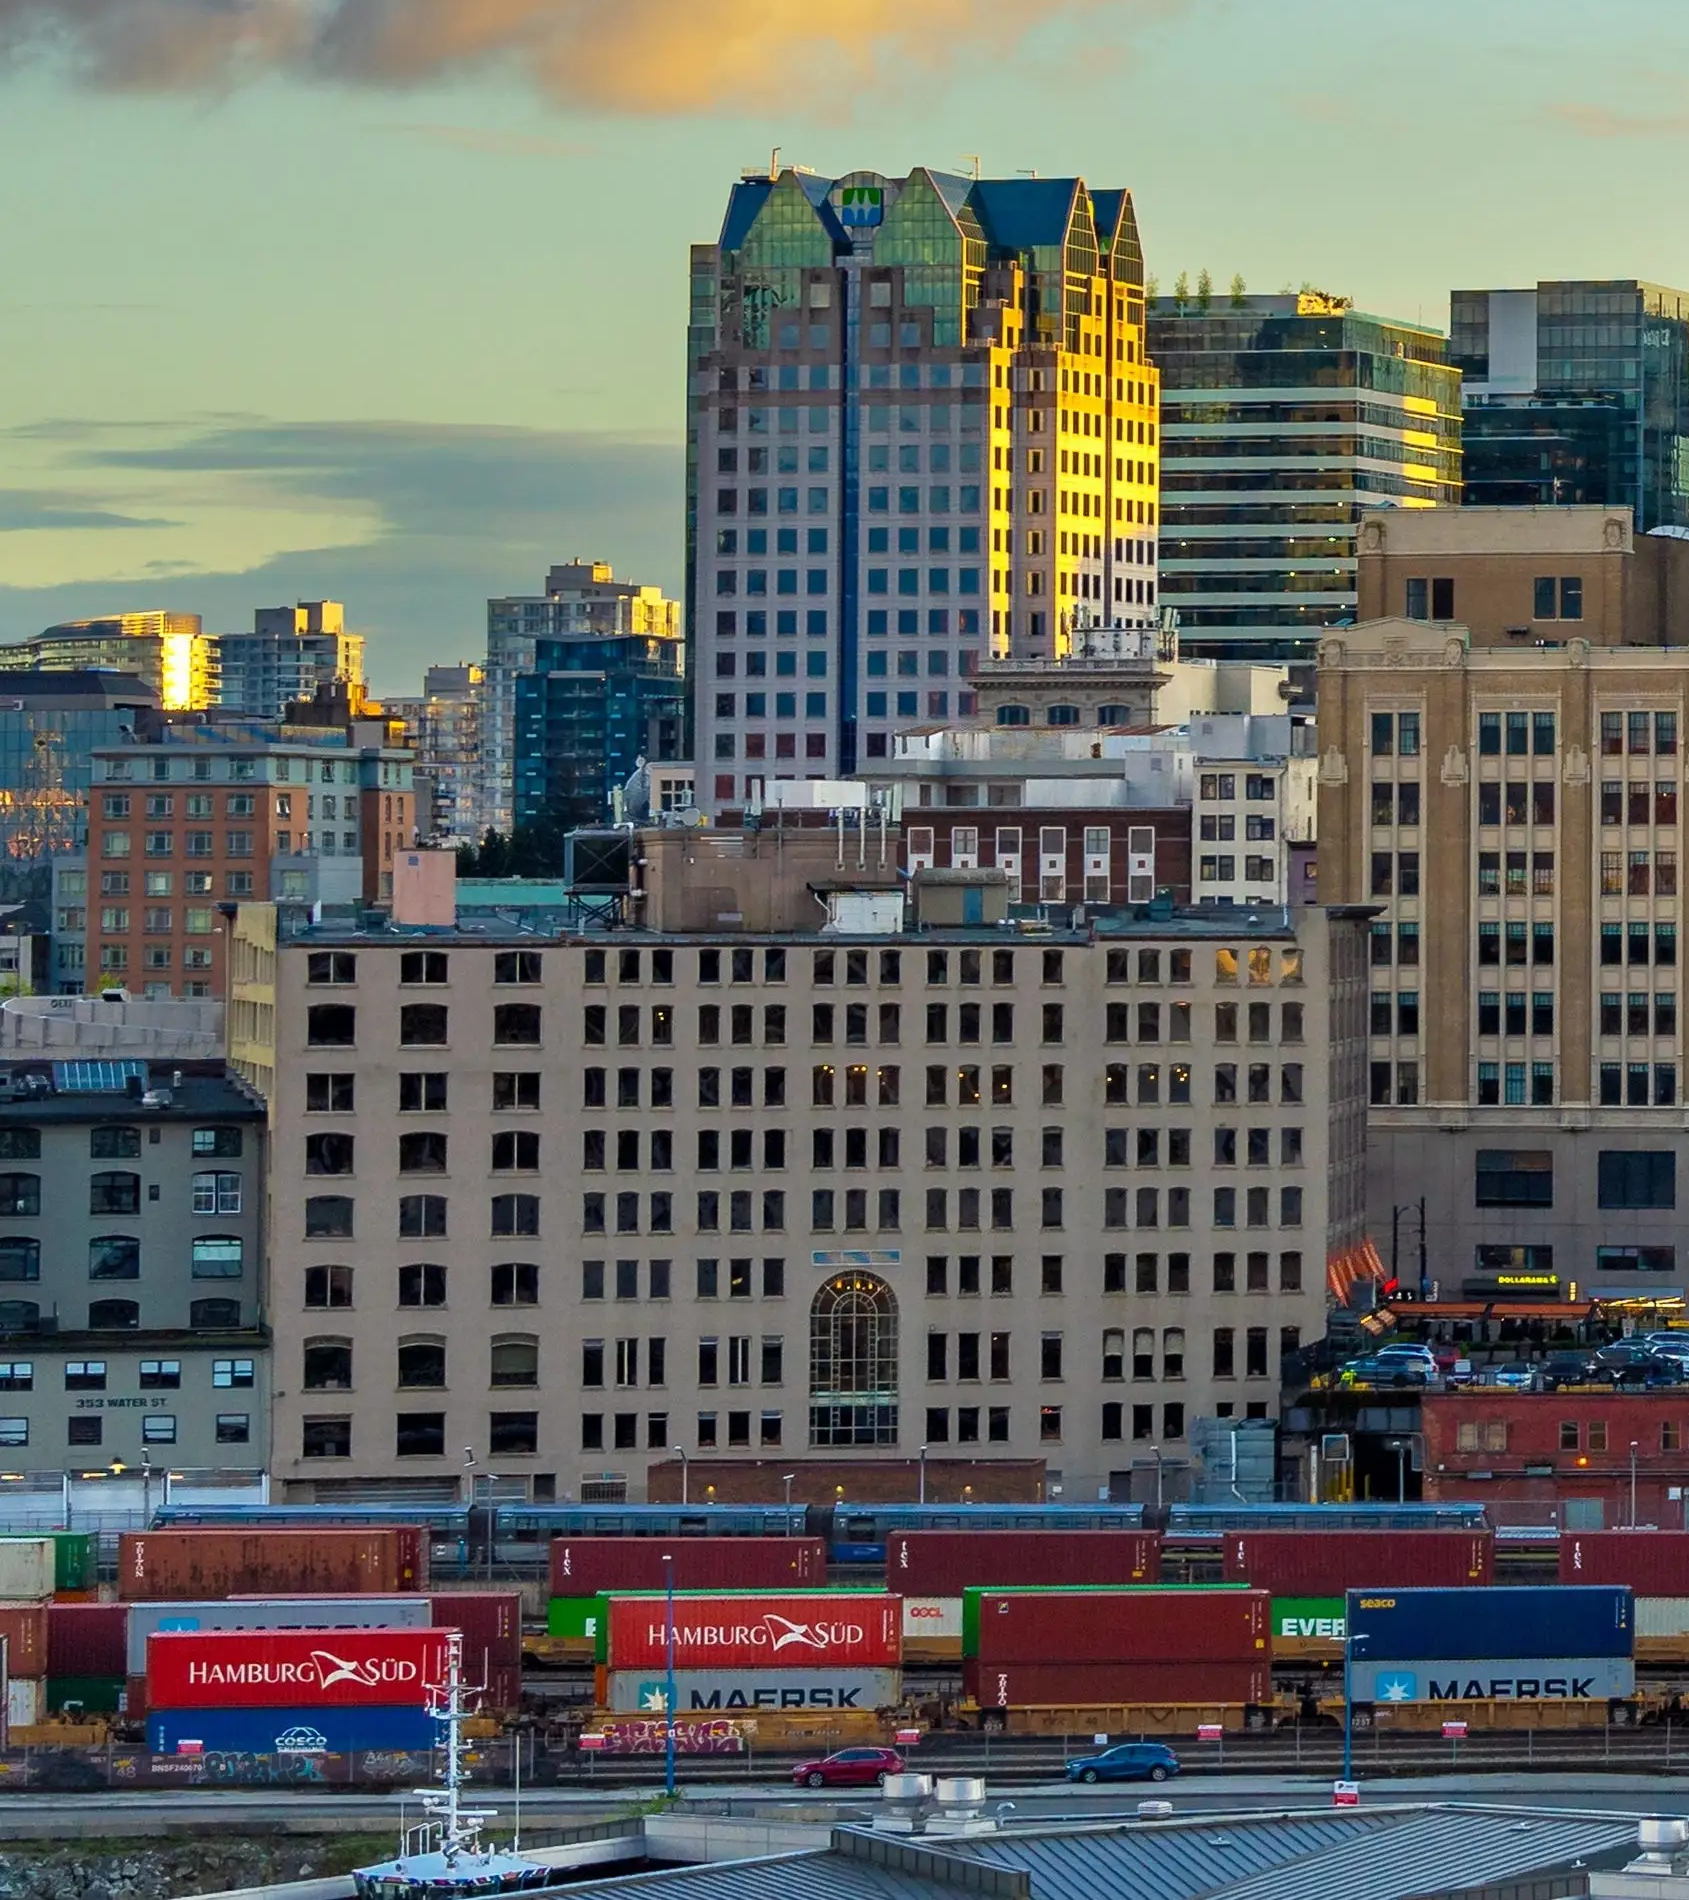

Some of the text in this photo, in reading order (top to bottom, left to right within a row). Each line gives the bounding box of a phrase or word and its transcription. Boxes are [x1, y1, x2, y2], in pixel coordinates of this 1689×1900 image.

[76, 1398, 105, 1409] 353
[107, 1398, 148, 1408] WATER
[135, 1541, 144, 1578] TRITON
[1359, 1598, 1396, 1609] seaco
[649, 1621, 864, 1646] HAMBURG SÜD
[189, 1658, 417, 1684] HAMBURG SÜD
[691, 1687, 863, 1709] MAERSK
[1428, 1677, 1597, 1699] MAERSK
[274, 1736, 328, 1747] COSCO
